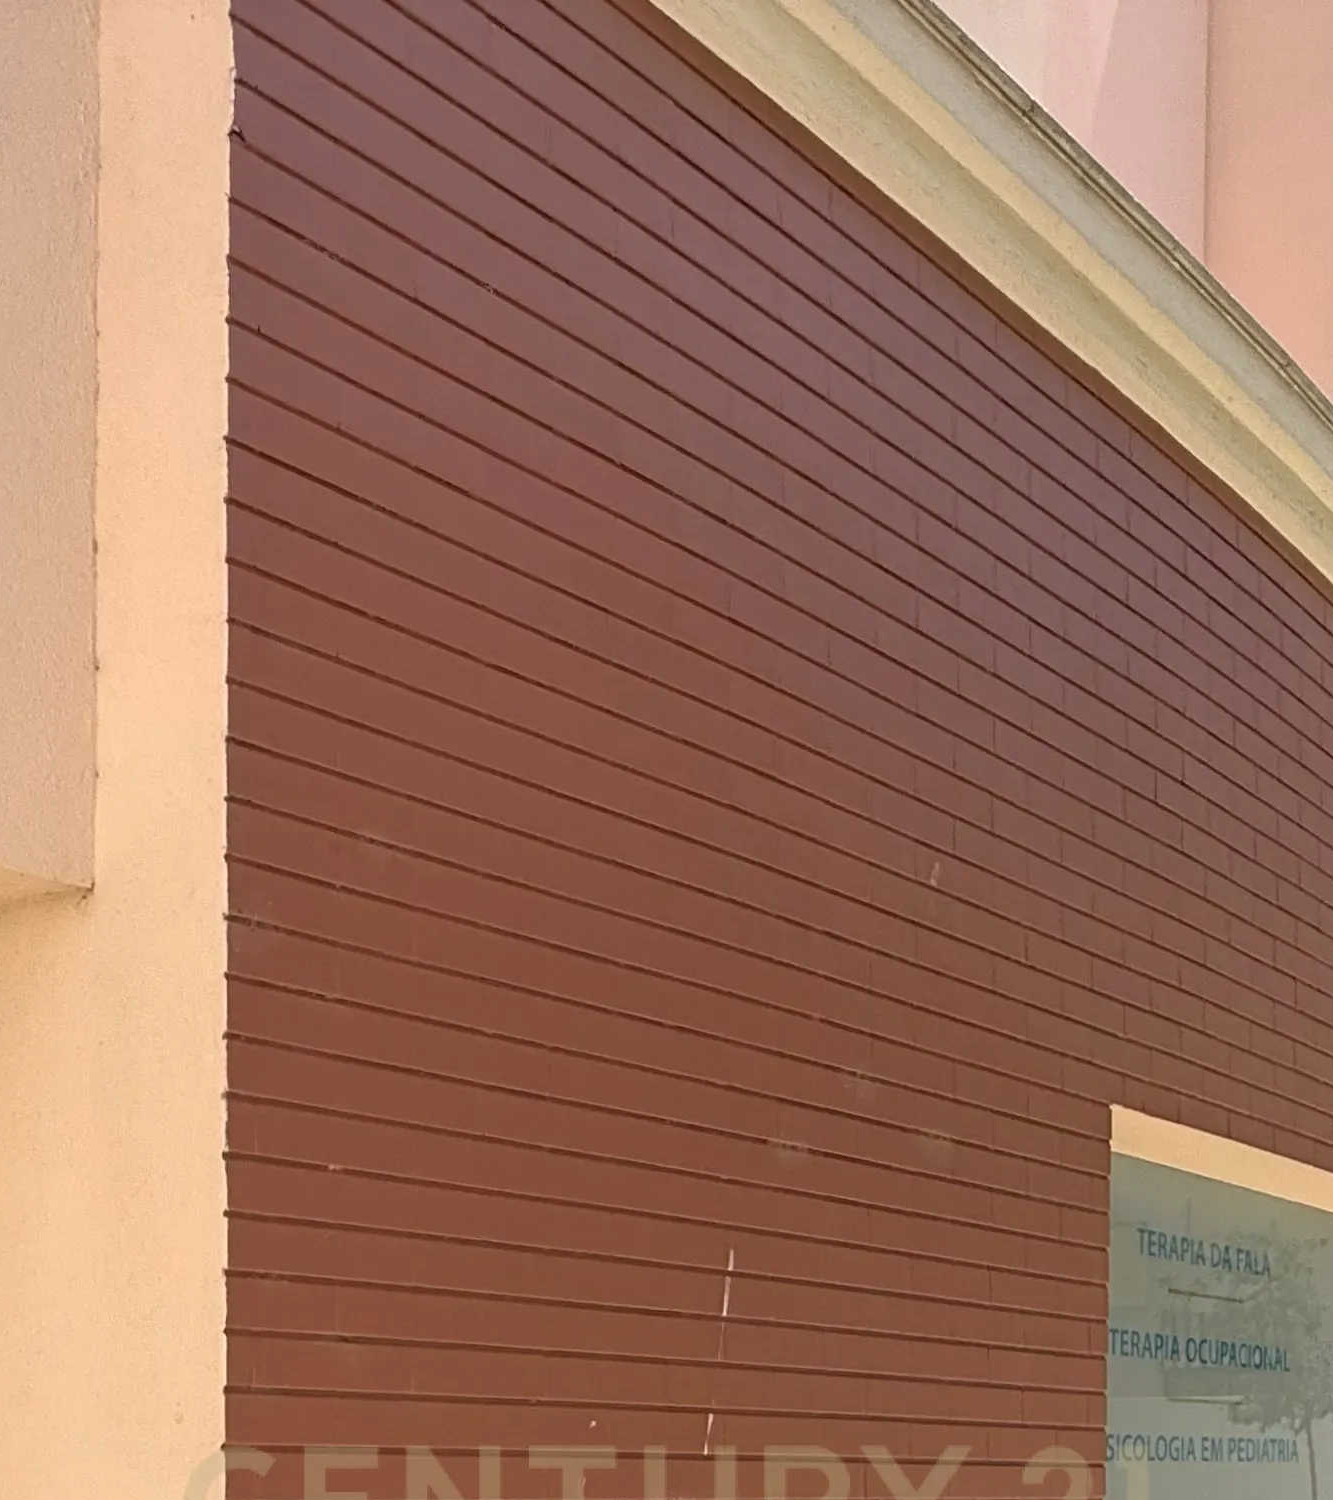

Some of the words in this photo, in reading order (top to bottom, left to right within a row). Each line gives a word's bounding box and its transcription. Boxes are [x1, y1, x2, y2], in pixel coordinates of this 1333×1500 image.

[1136, 1228, 1206, 1266] TERAPIA
[1210, 1243, 1232, 1271] DA
[1236, 1249, 1271, 1278] FALA
[1109, 1328, 1181, 1362] TERAPIA
[1185, 1337, 1291, 1373] OCUPACIONAL
[1106, 1433, 1196, 1462] SICOLOGIA
[1201, 1436, 1224, 1462] EM
[1228, 1437, 1300, 1463] PEDIATRIA
